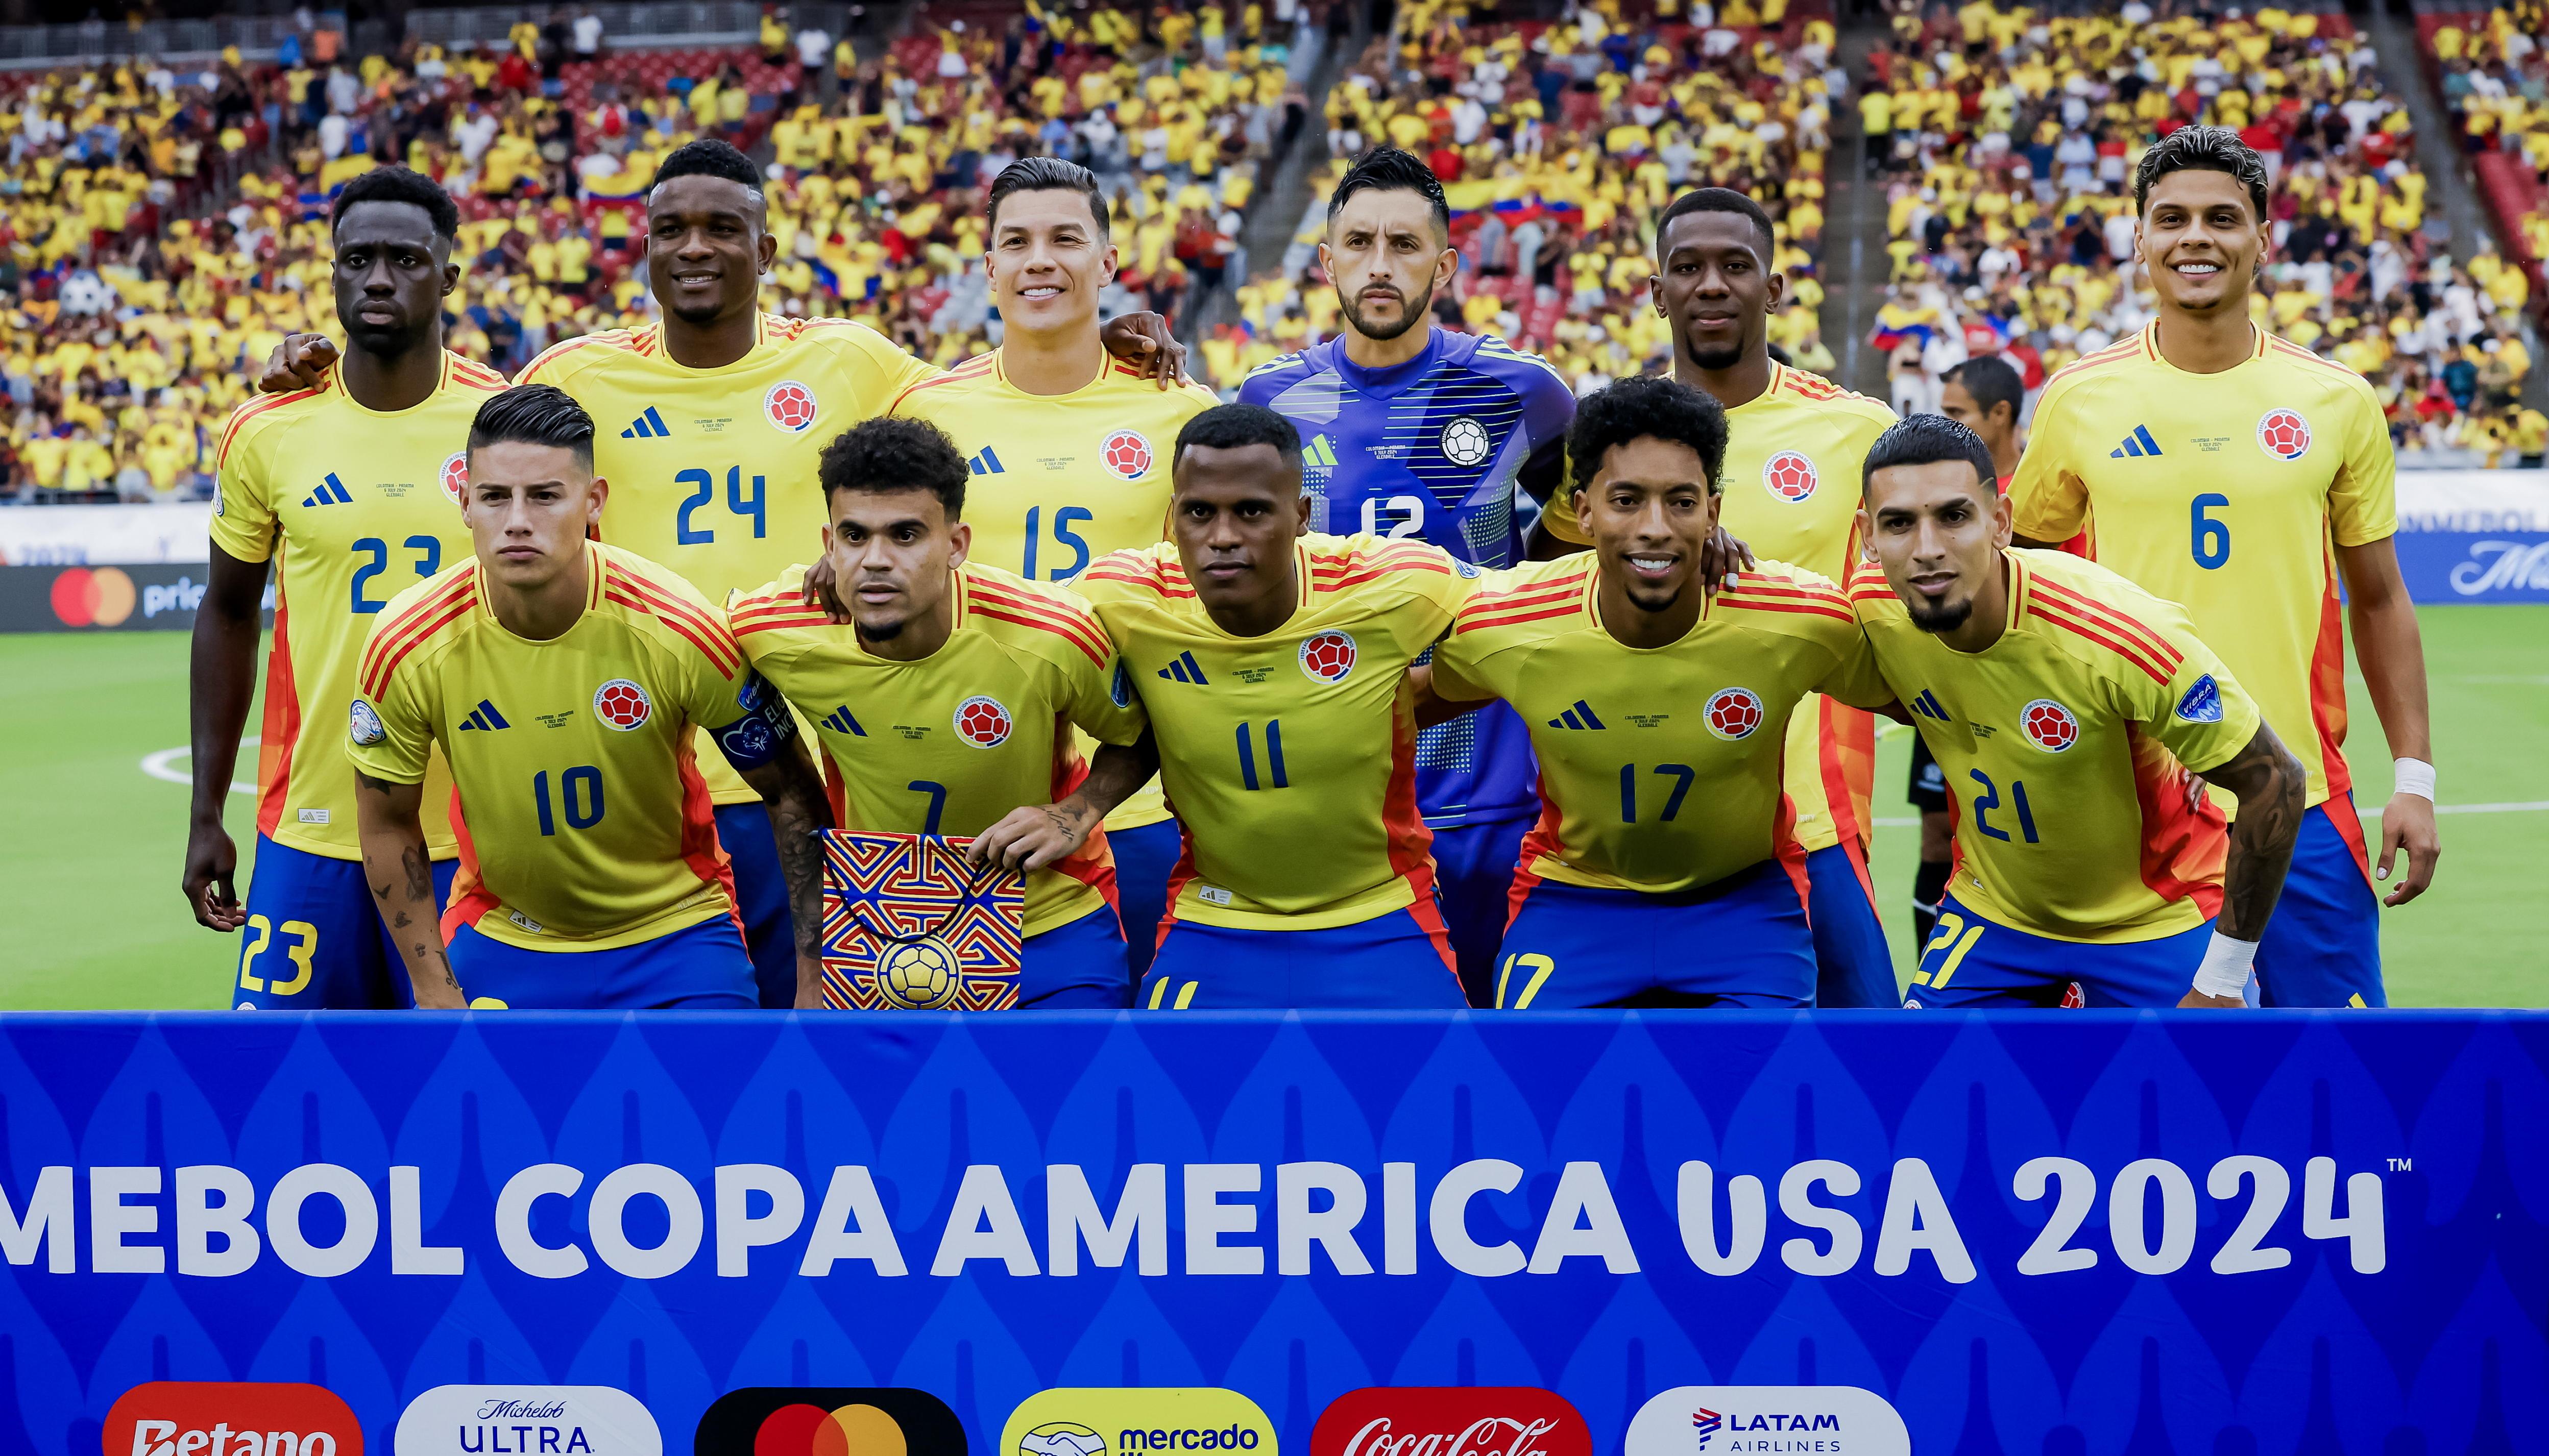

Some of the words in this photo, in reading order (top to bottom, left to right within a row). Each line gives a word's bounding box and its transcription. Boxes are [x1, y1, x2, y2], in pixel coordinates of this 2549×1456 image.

[675, 465, 765, 545] 24
[2191, 493, 2230, 570] 6
[351, 535, 441, 613] 23
[1023, 505, 1093, 581] 15
[2184, 684, 2212, 713] VIBRA
[1236, 720, 1288, 791] 11
[534, 766, 605, 836] 10
[908, 780, 946, 835] 7
[1621, 763, 1695, 823] 17
[1970, 768, 2040, 843] 21
[240, 914, 318, 996] 23
[1496, 953, 1555, 1009] 17
[1910, 912, 1985, 989] 21
[495, 1163, 909, 1279] COPA
[930, 1158, 1641, 1277] AMERICA
[1677, 1157, 1977, 1284] USA
[2013, 1155, 2386, 1275] 2024
[131, 1419, 337, 1456] Betano
[460, 1425, 592, 1454] ULTRA
[477, 1399, 568, 1419] Michelob
[1119, 1423, 1259, 1450] mercado
[1730, 1414, 1840, 1432] LATAM
[1730, 1441, 1841, 1452] AIRLINES
